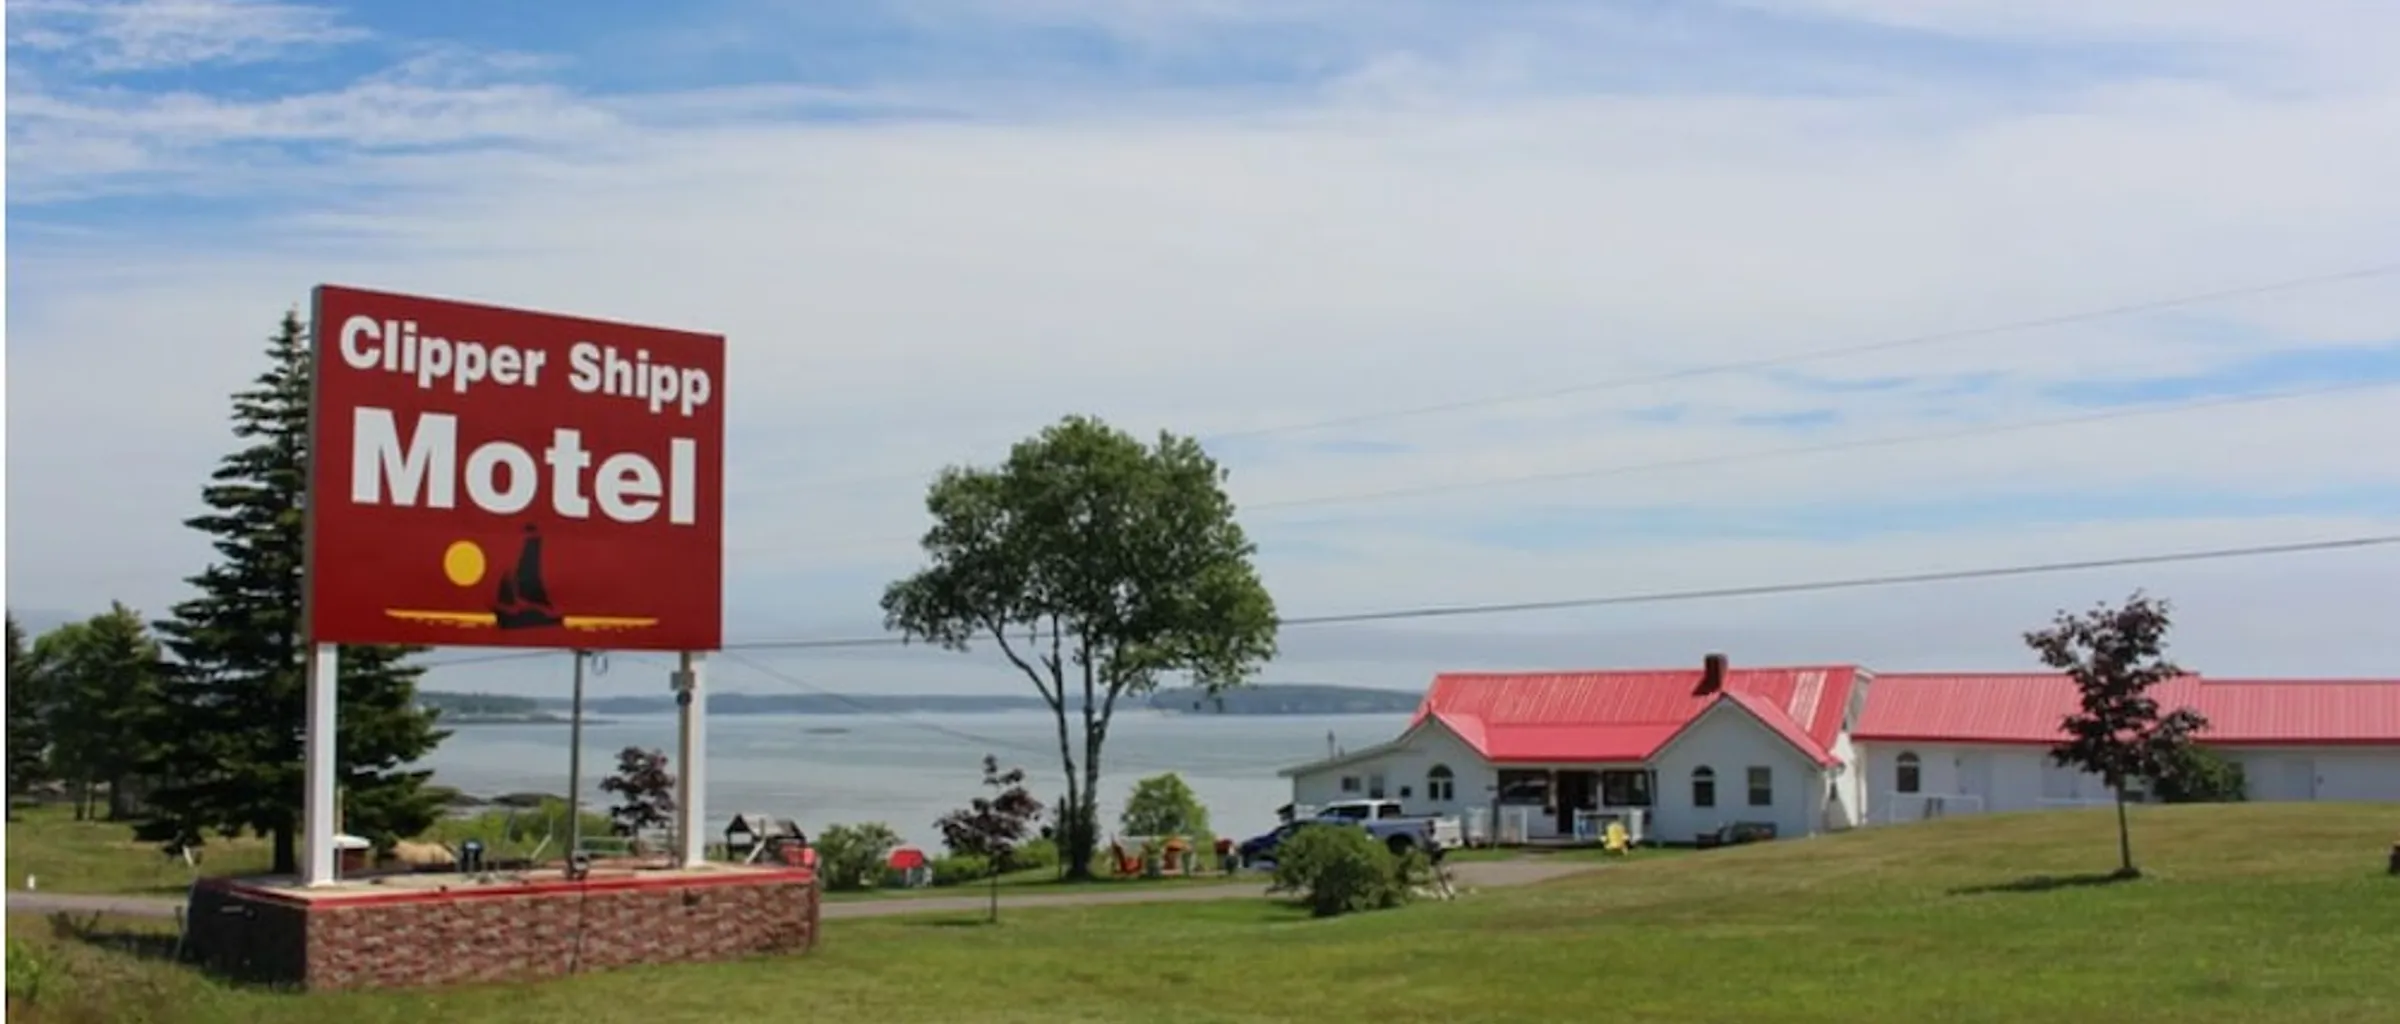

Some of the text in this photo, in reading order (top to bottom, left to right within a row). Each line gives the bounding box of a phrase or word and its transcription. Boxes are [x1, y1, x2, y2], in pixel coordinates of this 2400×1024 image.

[339, 315, 711, 416] Clipper Shipp
[351, 406, 697, 525] Motel
